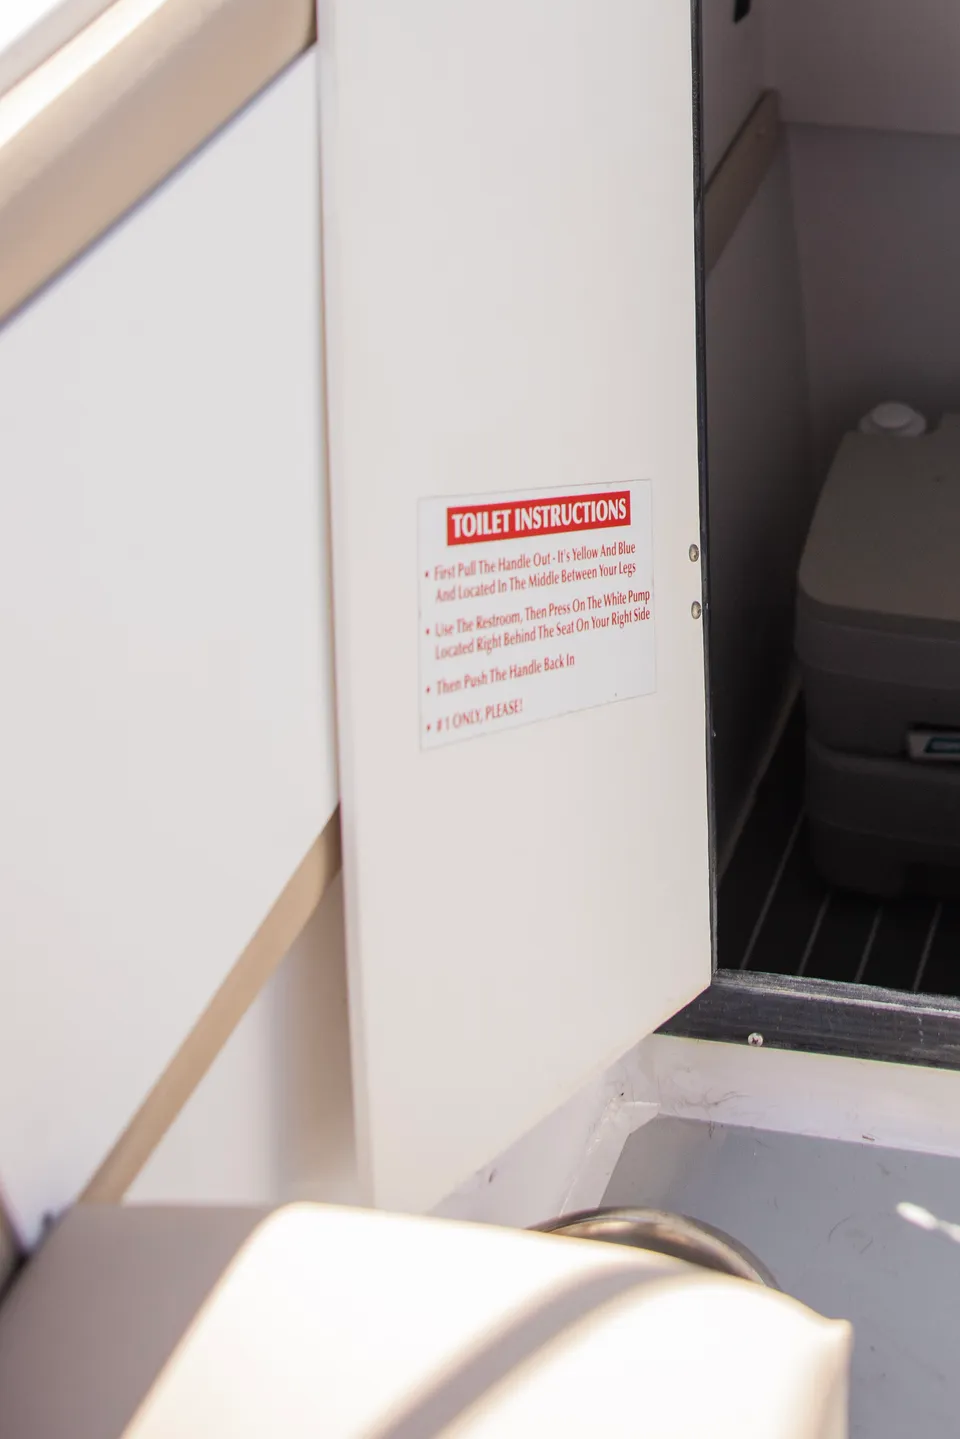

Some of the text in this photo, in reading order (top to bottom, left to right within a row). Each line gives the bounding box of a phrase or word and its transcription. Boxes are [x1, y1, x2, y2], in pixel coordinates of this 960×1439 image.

[452, 498, 627, 538] TOILET INSTRUCTIONS
[434, 564, 456, 580] First
[458, 560, 477, 577] Pull
[478, 558, 496, 575] The
[498, 553, 531, 571] Handle
[533, 552, 551, 566] Out
[557, 549, 571, 563] It's
[572, 545, 599, 561] Yellow
[600, 542, 617, 557] And
[618, 540, 636, 555] Blue
[435, 561, 636, 603] And Located In The Middle Between Your Legs
[435, 590, 651, 637] Use The Restroom, Then Press On The White Pump
[435, 607, 651, 660] Located Right Behind The Seat On Your Right Side
[437, 652, 575, 696] Then Push The Handle Back In
[452, 708, 483, 729] ONLY,
[485, 698, 523, 720] PLEASE!
